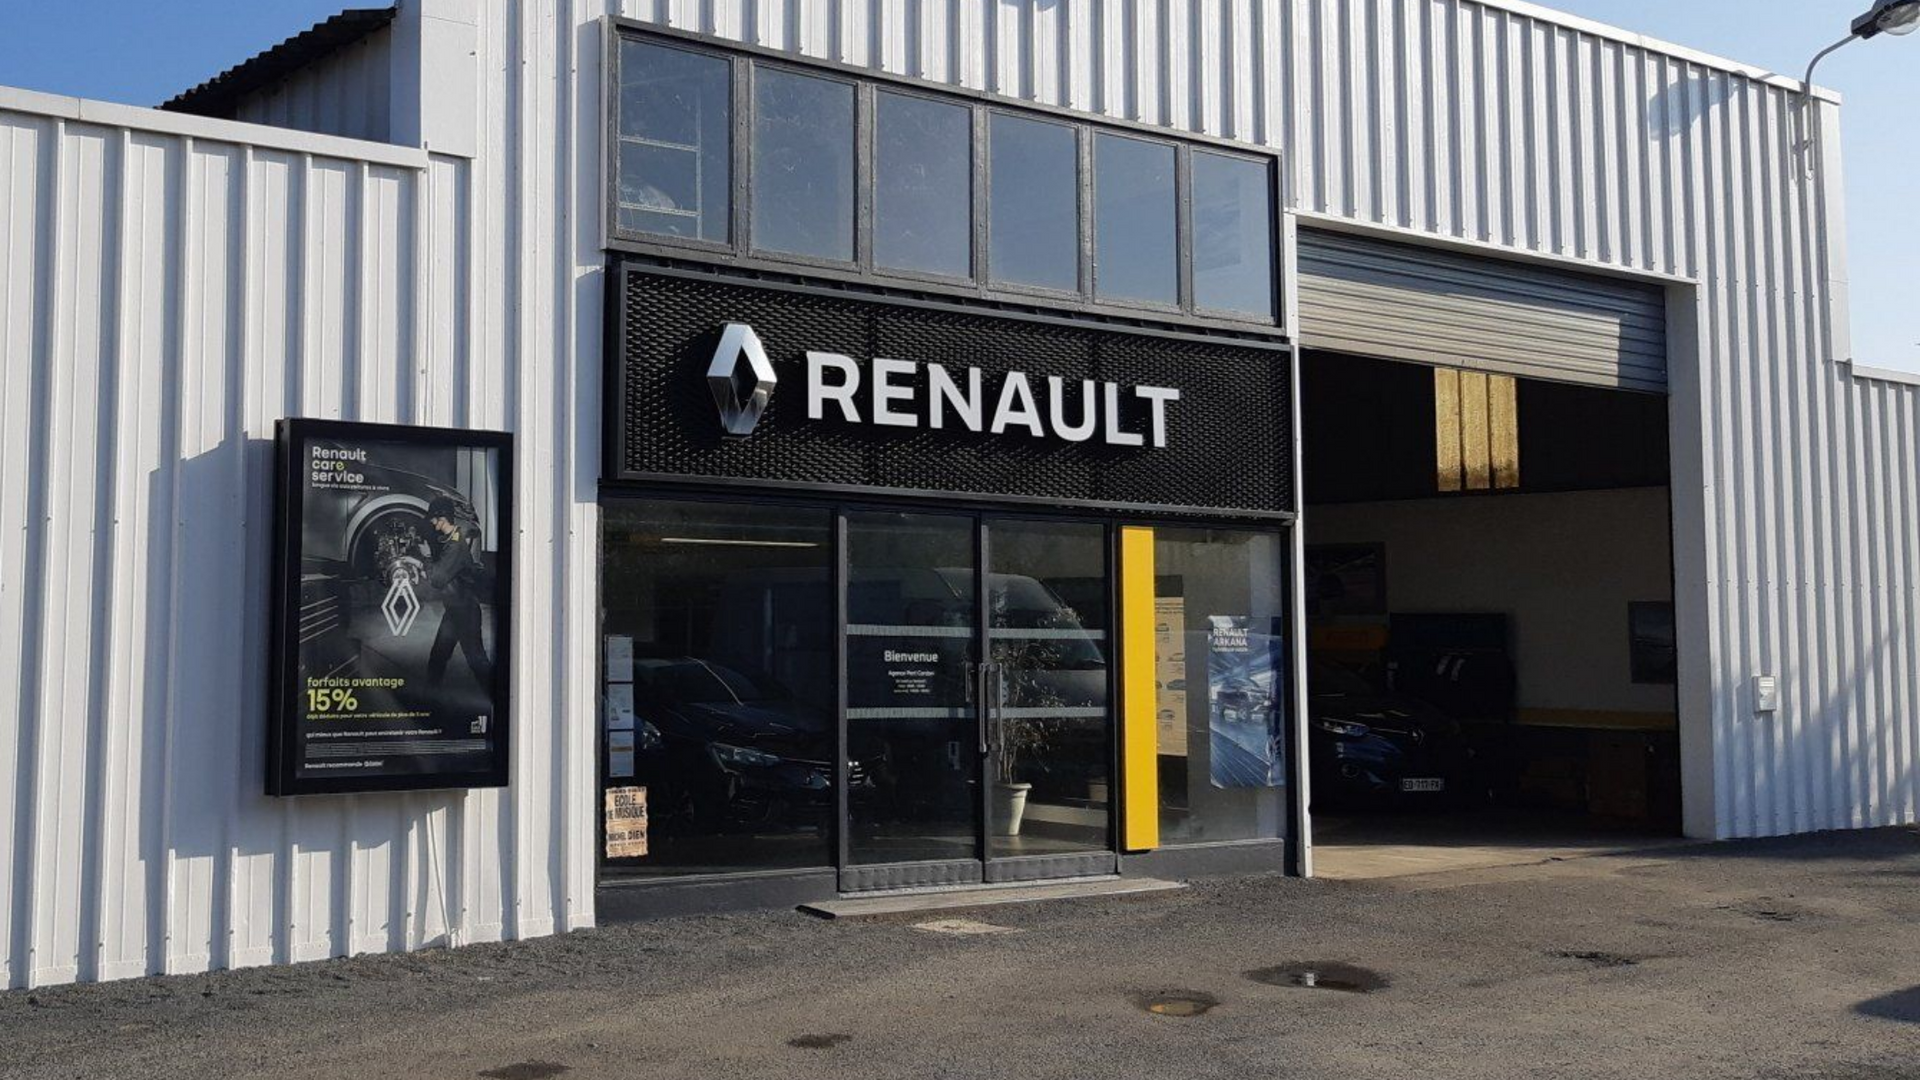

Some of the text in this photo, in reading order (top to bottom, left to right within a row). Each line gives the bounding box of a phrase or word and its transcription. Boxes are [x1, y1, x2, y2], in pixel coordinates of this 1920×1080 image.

[806, 351, 1180, 447] RENAULT
[311, 446, 367, 461] Renault
[311, 459, 345, 471] care
[311, 470, 365, 484] service
[1213, 627, 1249, 637] RENAULT
[1213, 637, 1248, 647] ARKANA
[884, 650, 938, 662] Bienvenue
[307, 676, 405, 689] forfaits avantage
[306, 688, 358, 712] 15%
[614, 806, 644, 819] MUSIQUE
[628, 830, 645, 840] DIEN
